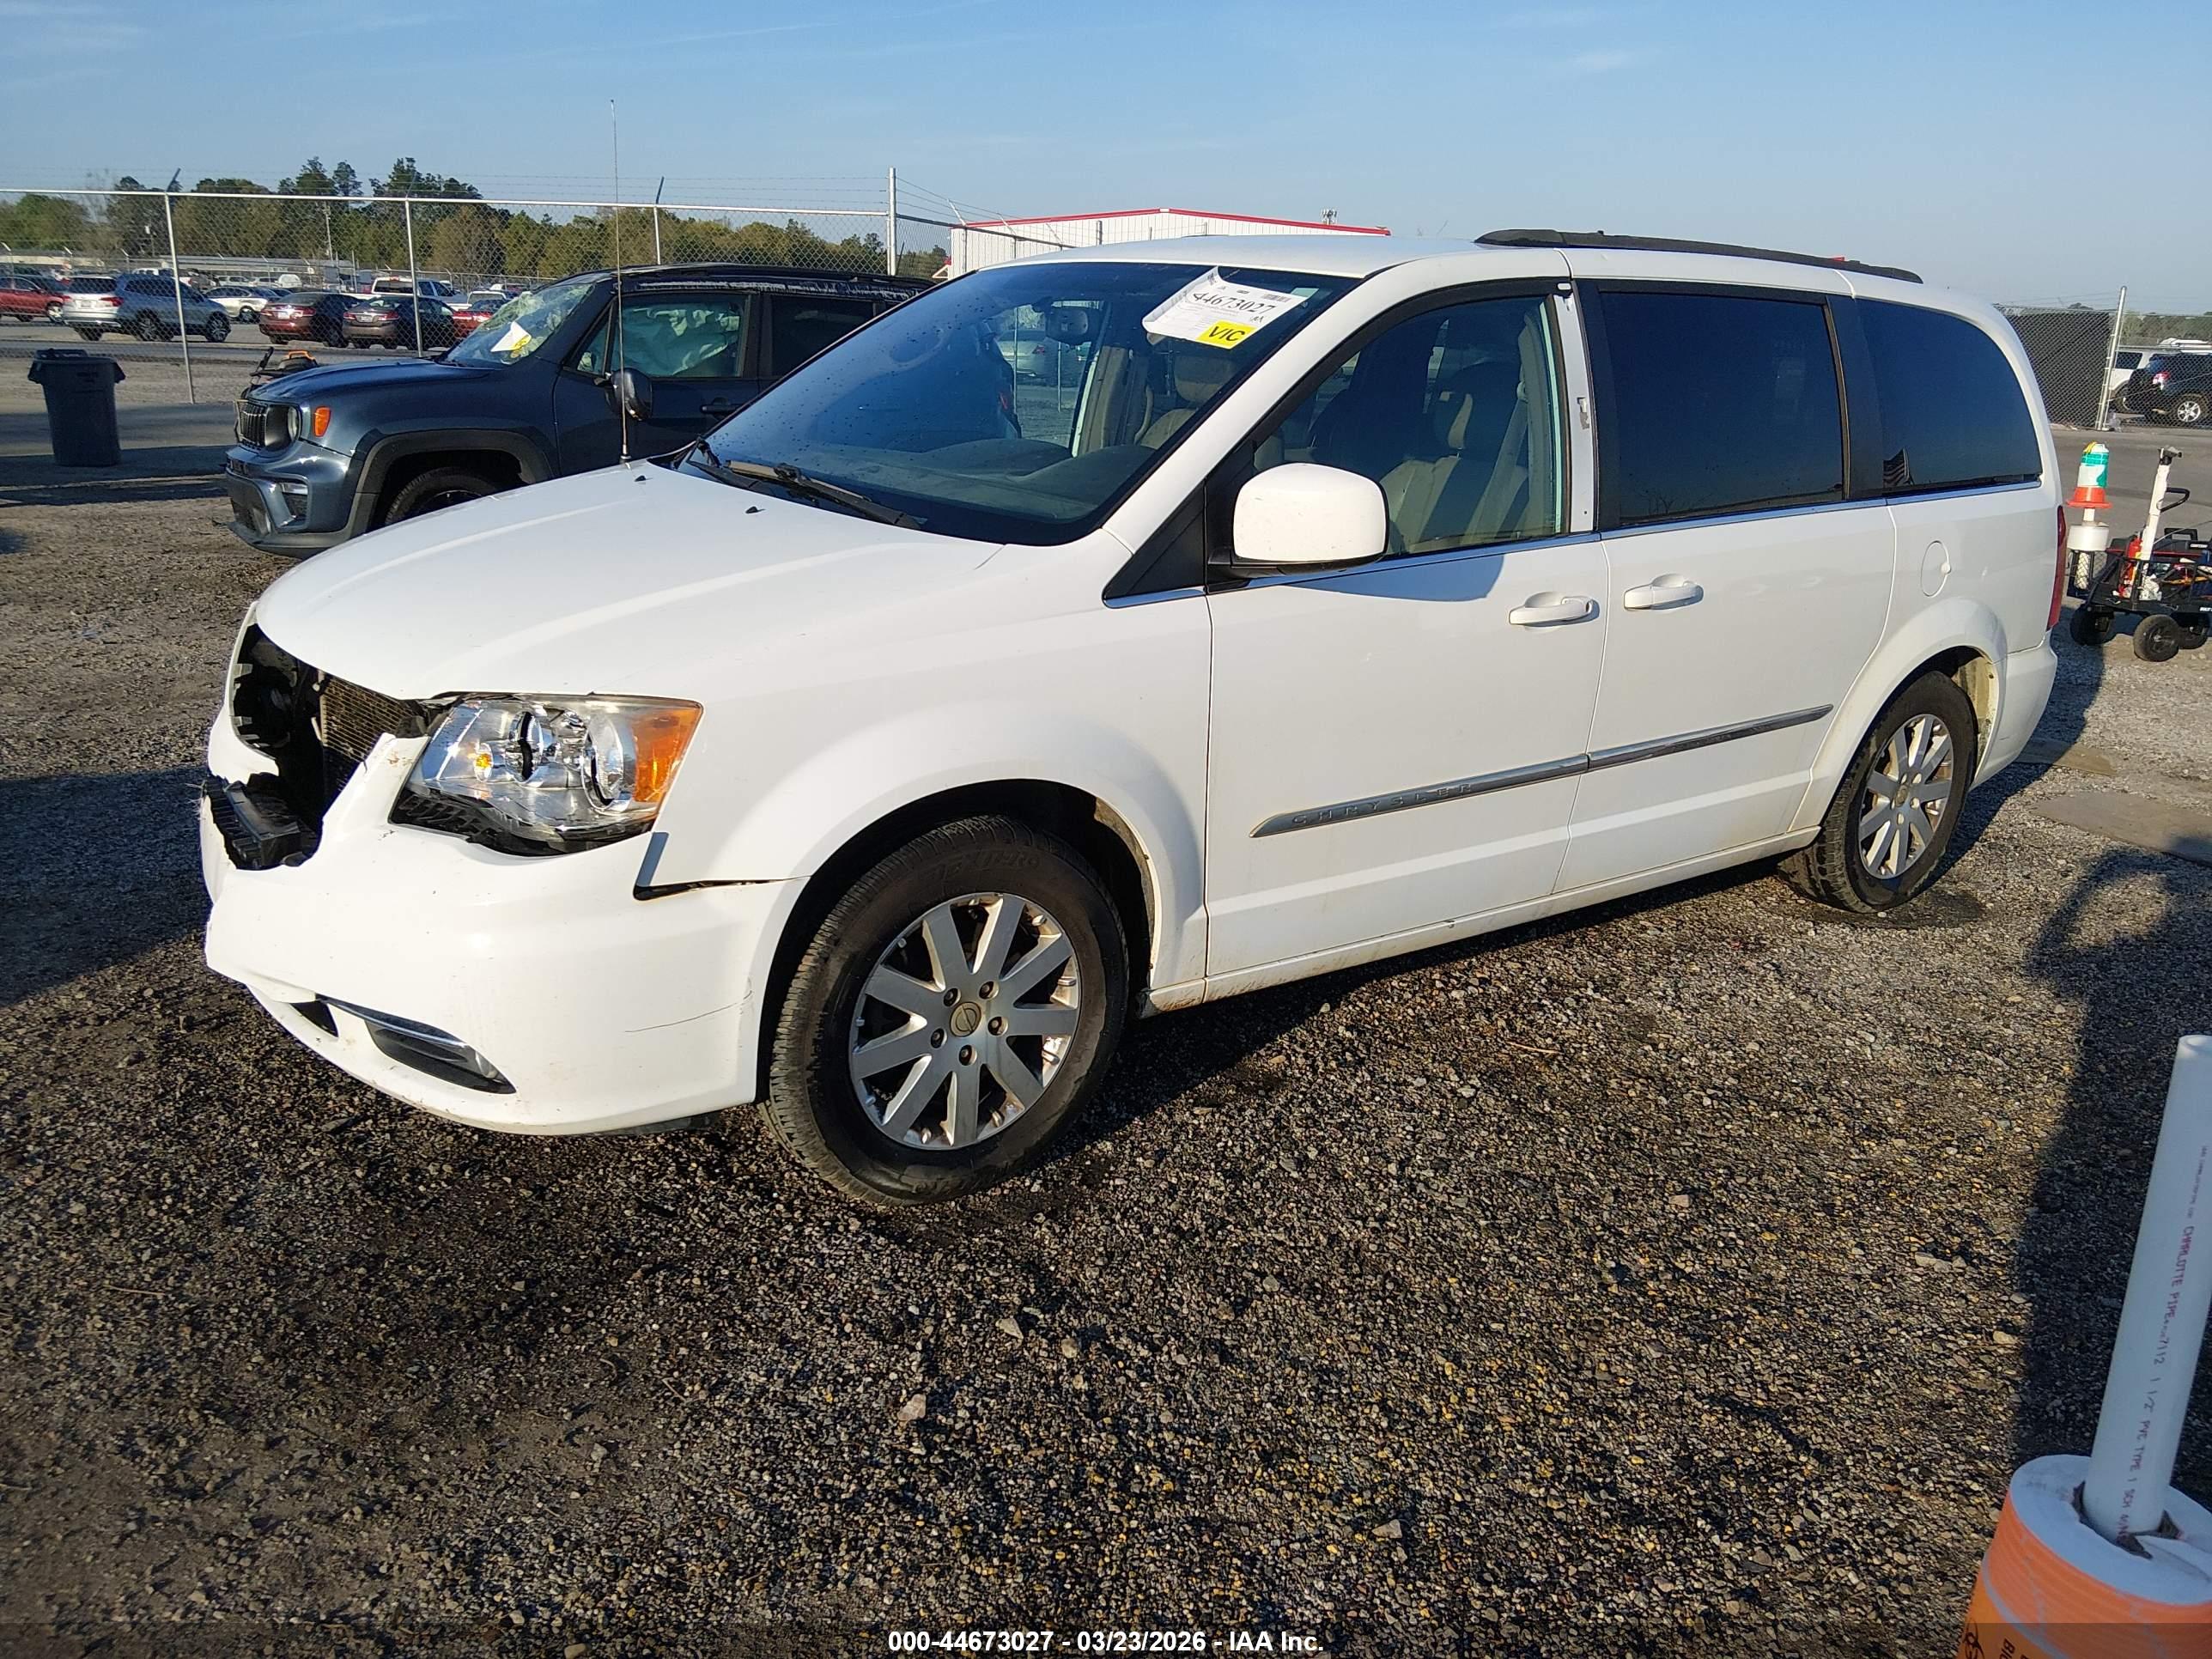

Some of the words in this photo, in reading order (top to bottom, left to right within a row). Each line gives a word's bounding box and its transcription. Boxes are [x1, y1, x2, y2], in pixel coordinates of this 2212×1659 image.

[1193, 291, 1278, 314] 44673027
[1208, 325, 1245, 342] VIC
[1291, 782, 1472, 824] CHRYSLER
[2171, 1224, 2195, 1287] CHARLOTTE
[2136, 1419, 2151, 1441] PVC
[2129, 1446, 2145, 1473] TYPE
